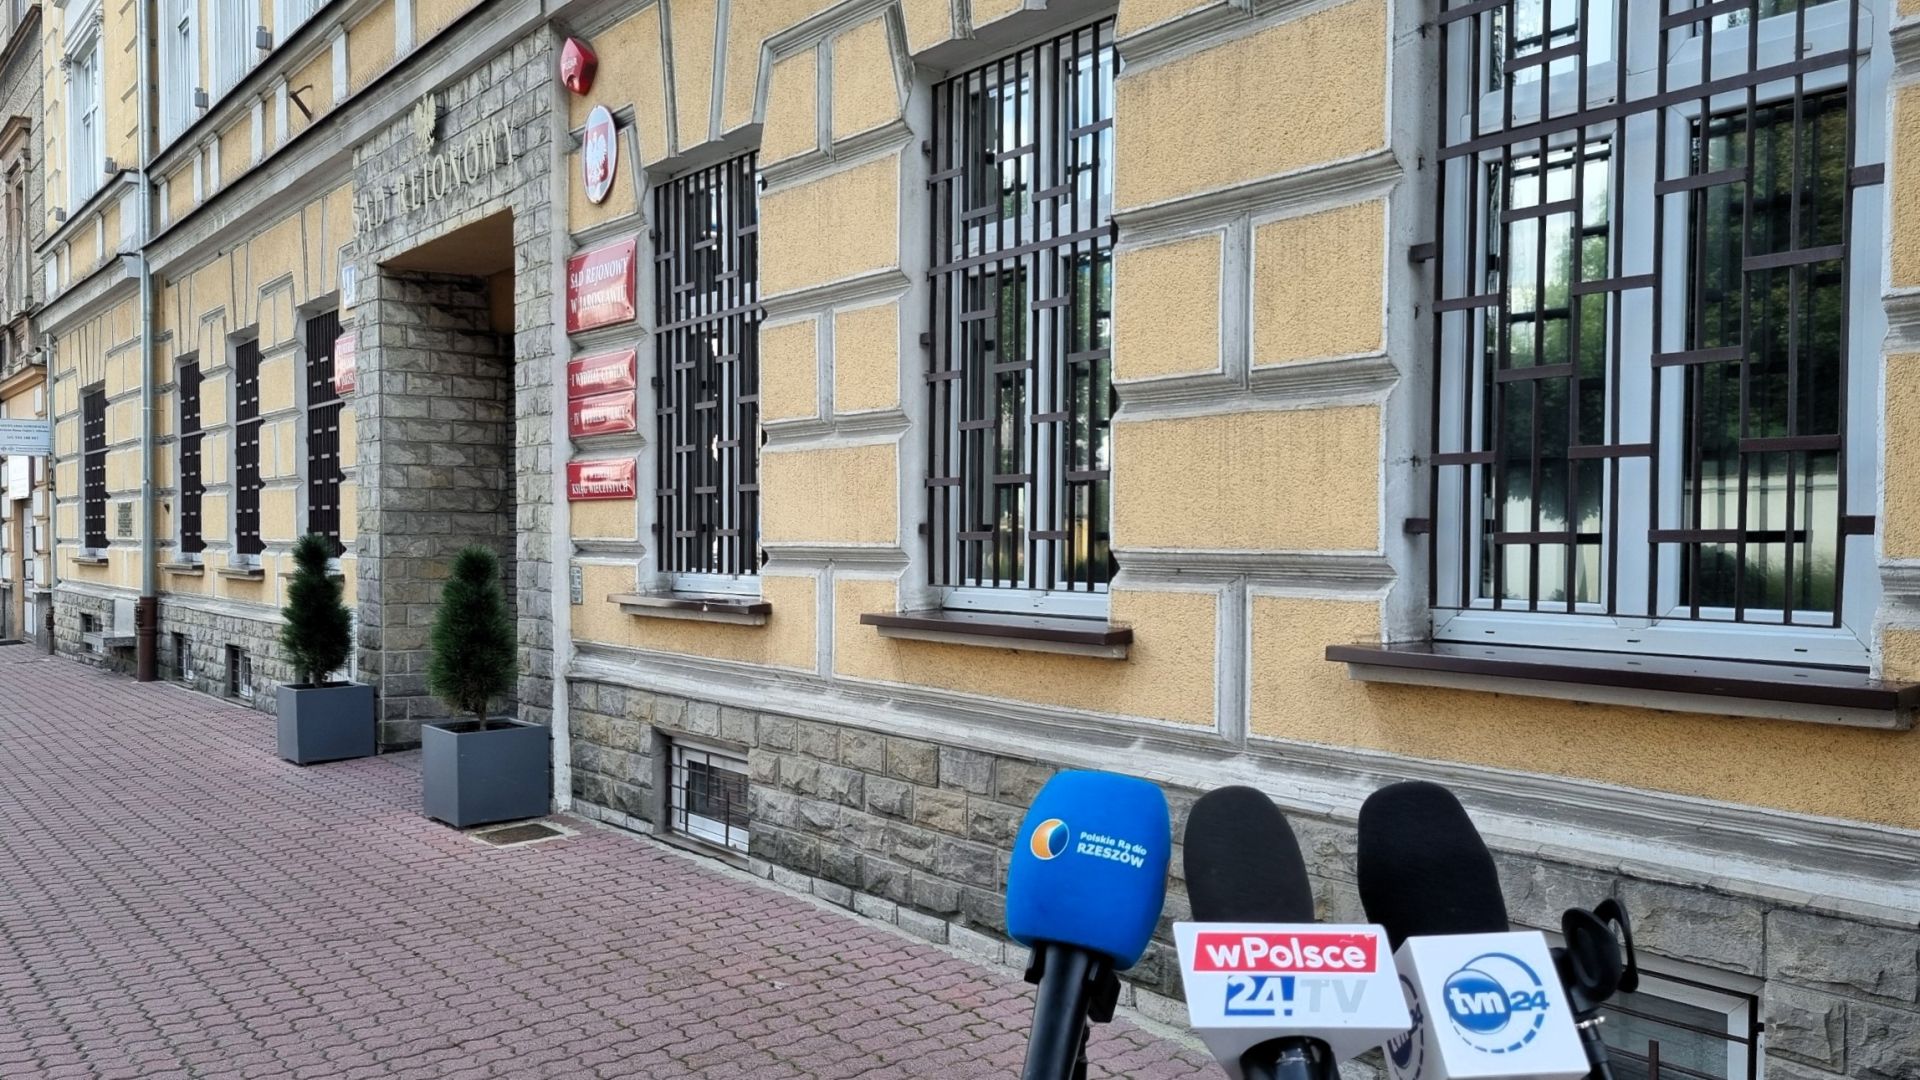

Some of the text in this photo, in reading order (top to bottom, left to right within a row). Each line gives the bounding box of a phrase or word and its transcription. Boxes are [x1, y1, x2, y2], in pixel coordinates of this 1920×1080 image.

[397, 114, 515, 222] REJONOWY
[586, 257, 628, 287] REJONOWY
[1080, 831, 1115, 846] Polskie
[1076, 842, 1144, 868] RZESZÓW
[1205, 937, 1367, 969] wPolsce
[1300, 979, 1368, 1013] TV
